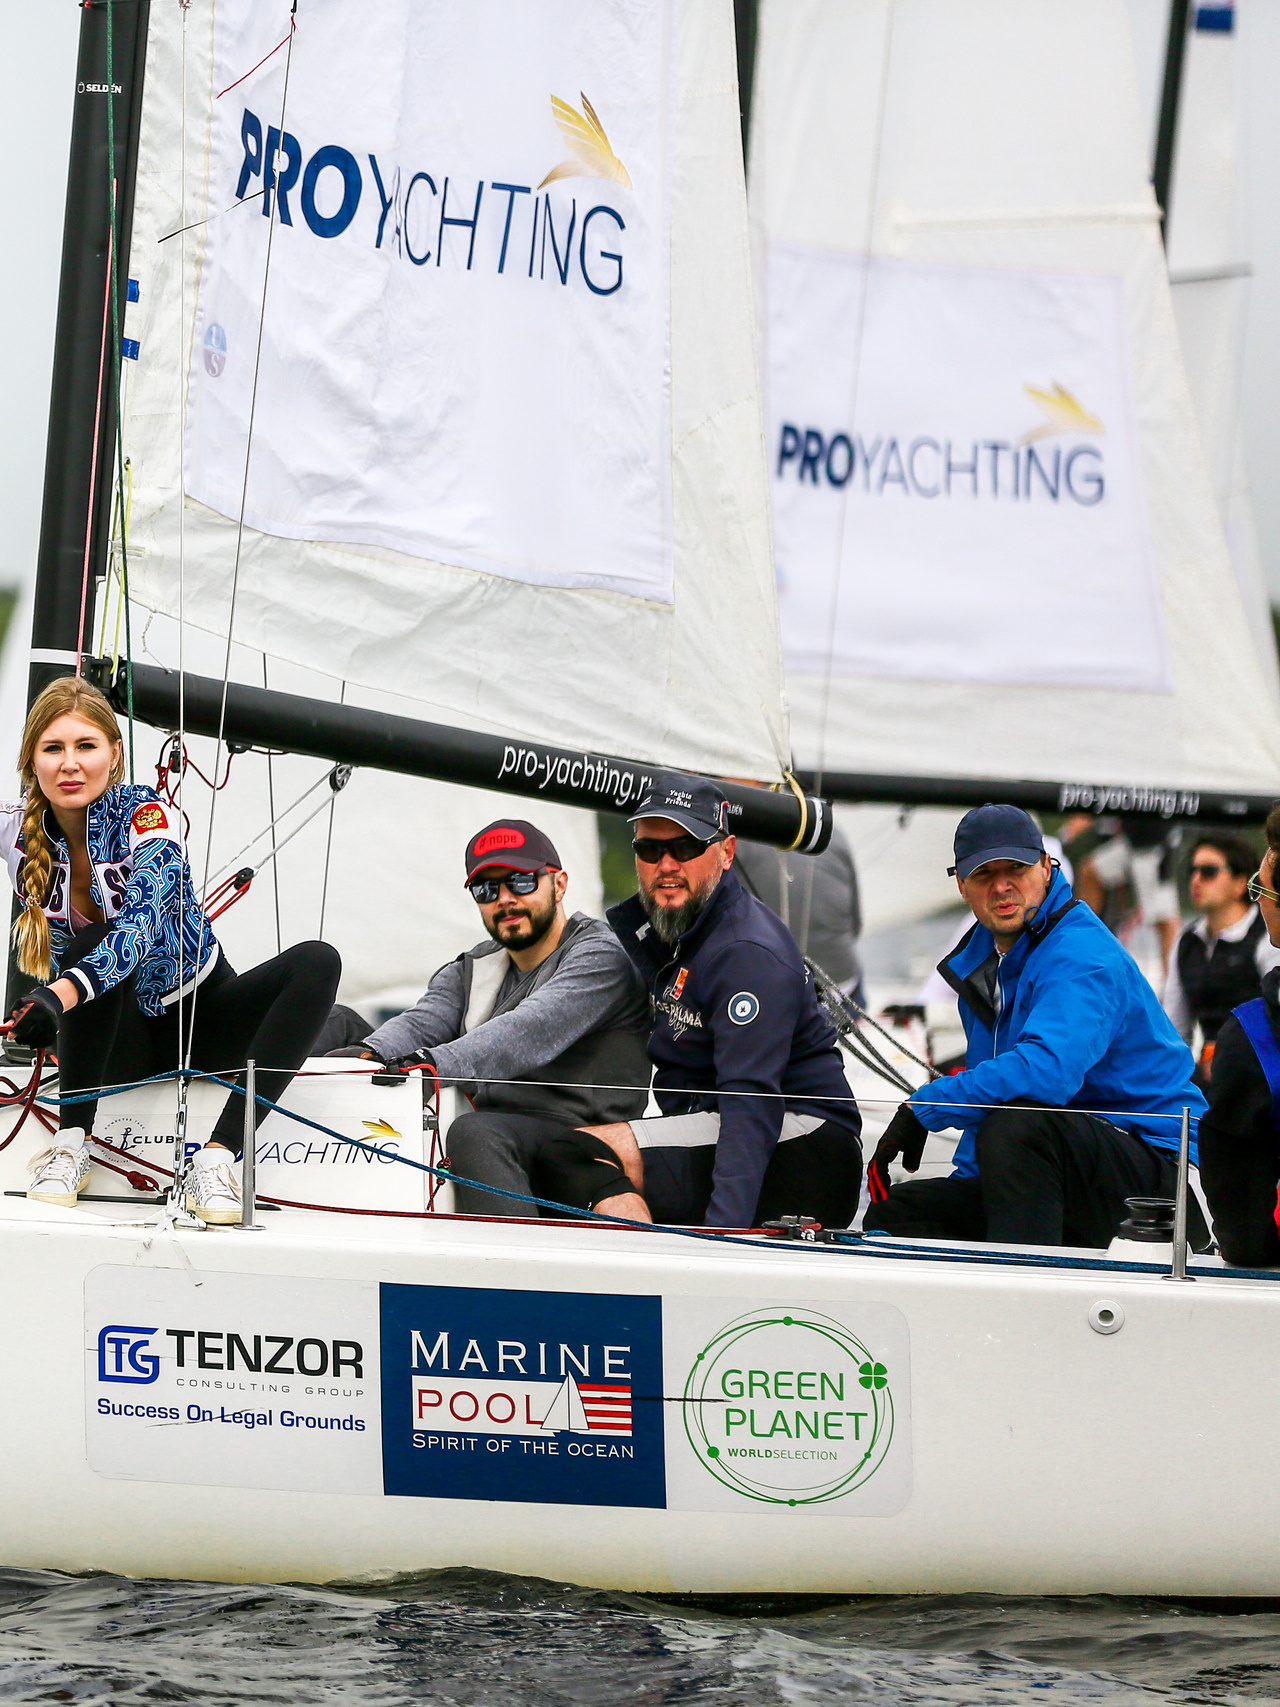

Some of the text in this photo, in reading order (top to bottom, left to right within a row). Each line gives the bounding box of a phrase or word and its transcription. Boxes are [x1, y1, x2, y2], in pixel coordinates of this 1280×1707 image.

[776, 424, 1106, 506] PROYACHTING
[489, 834, 517, 845] nope
[133, 1135, 175, 1144] CLUB
[166, 1329, 364, 1379] TENZOR
[410, 1330, 632, 1380] MARINE
[176, 1378, 364, 1398] CONSULTING GROUP
[721, 1369, 844, 1402] GREEN
[98, 1398, 366, 1431] Success On Legal Grounds
[418, 1389, 544, 1425] POOL
[725, 1408, 868, 1441] PLANET
[412, 1433, 634, 1459] SPIRIT OF THE OCEAN
[727, 1448, 838, 1461] WORLDSELECTION
